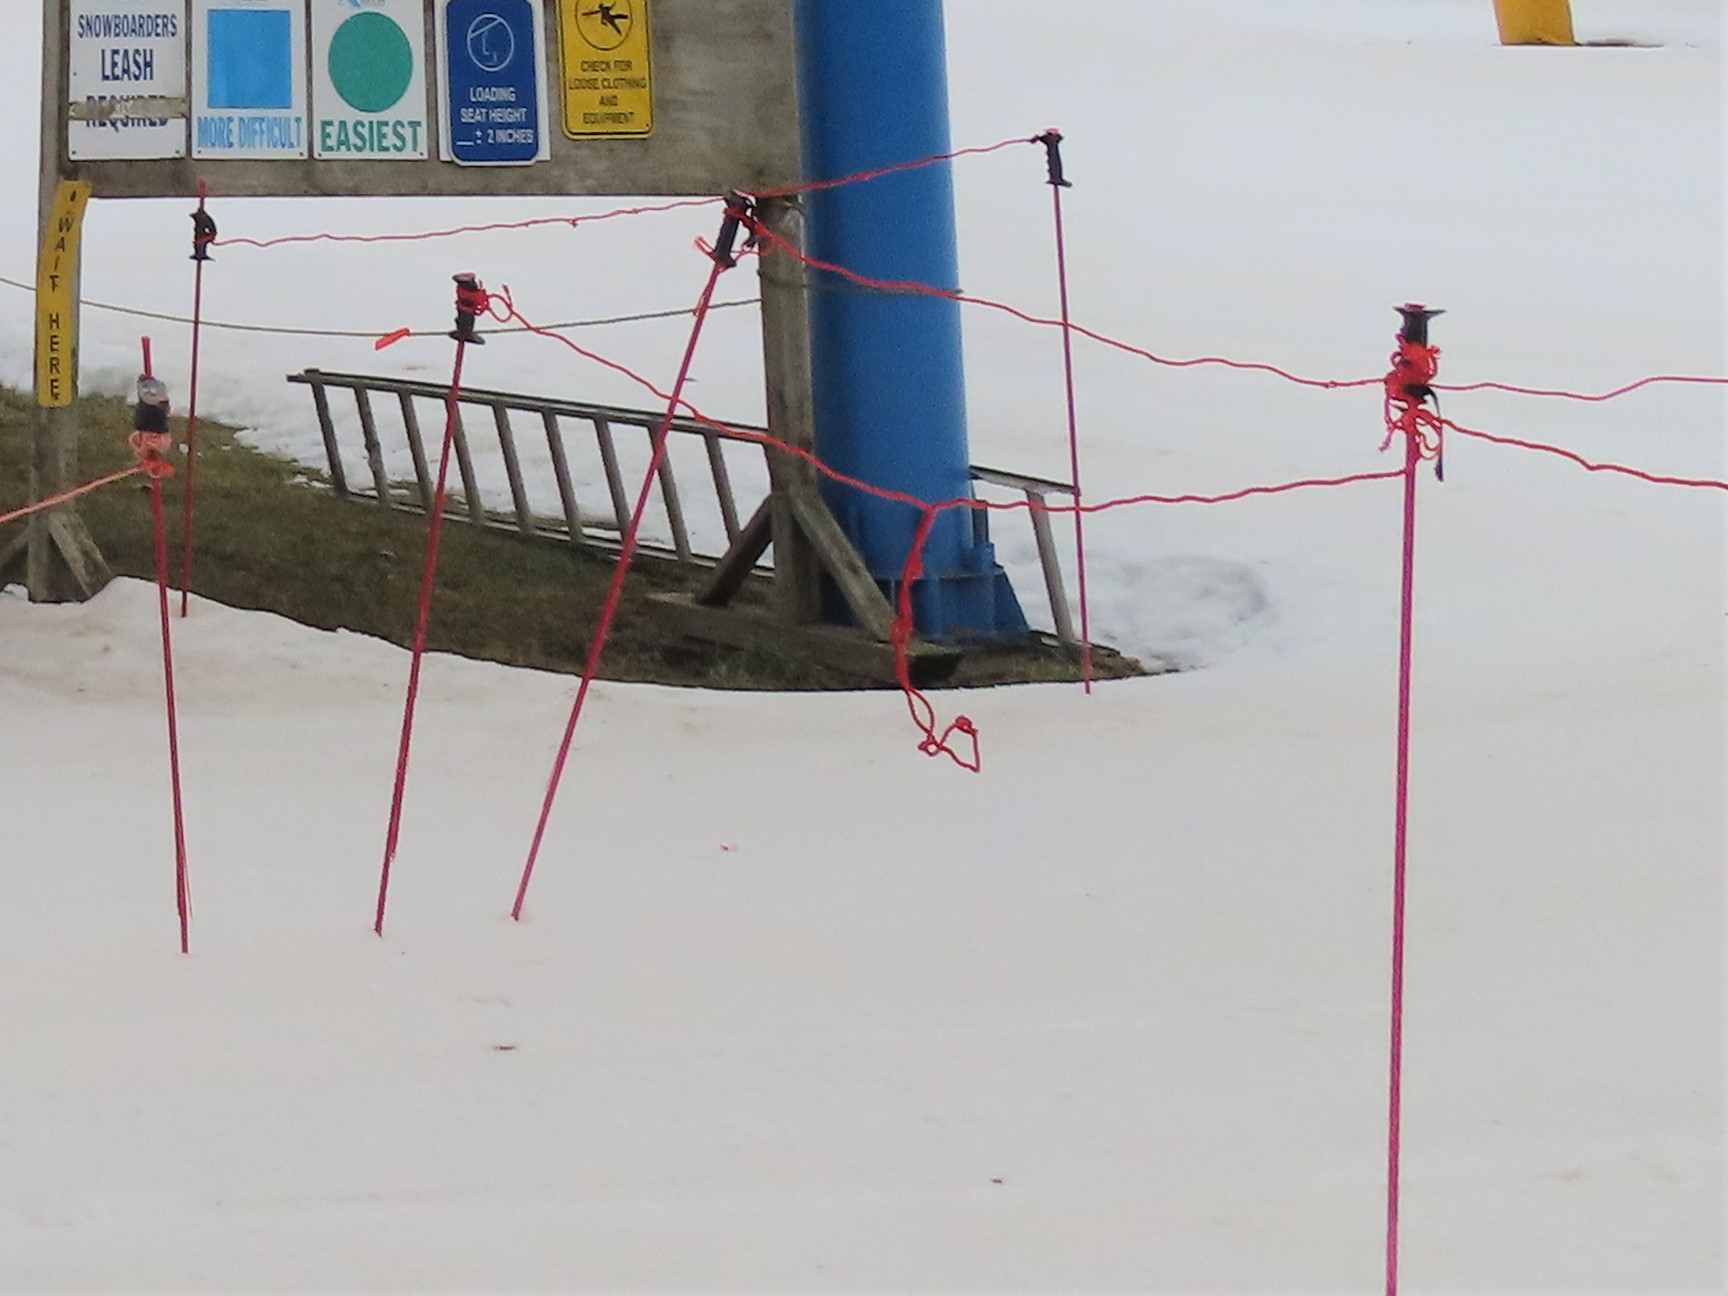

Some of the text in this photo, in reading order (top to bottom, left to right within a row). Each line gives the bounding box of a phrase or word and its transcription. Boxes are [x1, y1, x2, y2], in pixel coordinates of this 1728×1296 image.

[78, 14, 177, 39] SNOWBOARDERS
[101, 49, 154, 81] LEASH
[580, 60, 633, 73] CHECK FOR
[569, 78, 647, 89] LOOSE CLOTHING
[470, 86, 516, 102] LOADING
[599, 96, 618, 106] AND
[460, 108, 527, 123] SEAT HEIGHT
[583, 112, 635, 125] EQUIPMENT
[197, 116, 302, 149] MORE DIFFICULT
[320, 119, 422, 153] EASIEST
[487, 131, 494, 144] 2
[496, 128, 535, 144] INCHES
[49, 217, 75, 294] WAIT
[49, 313, 60, 401] HERE
